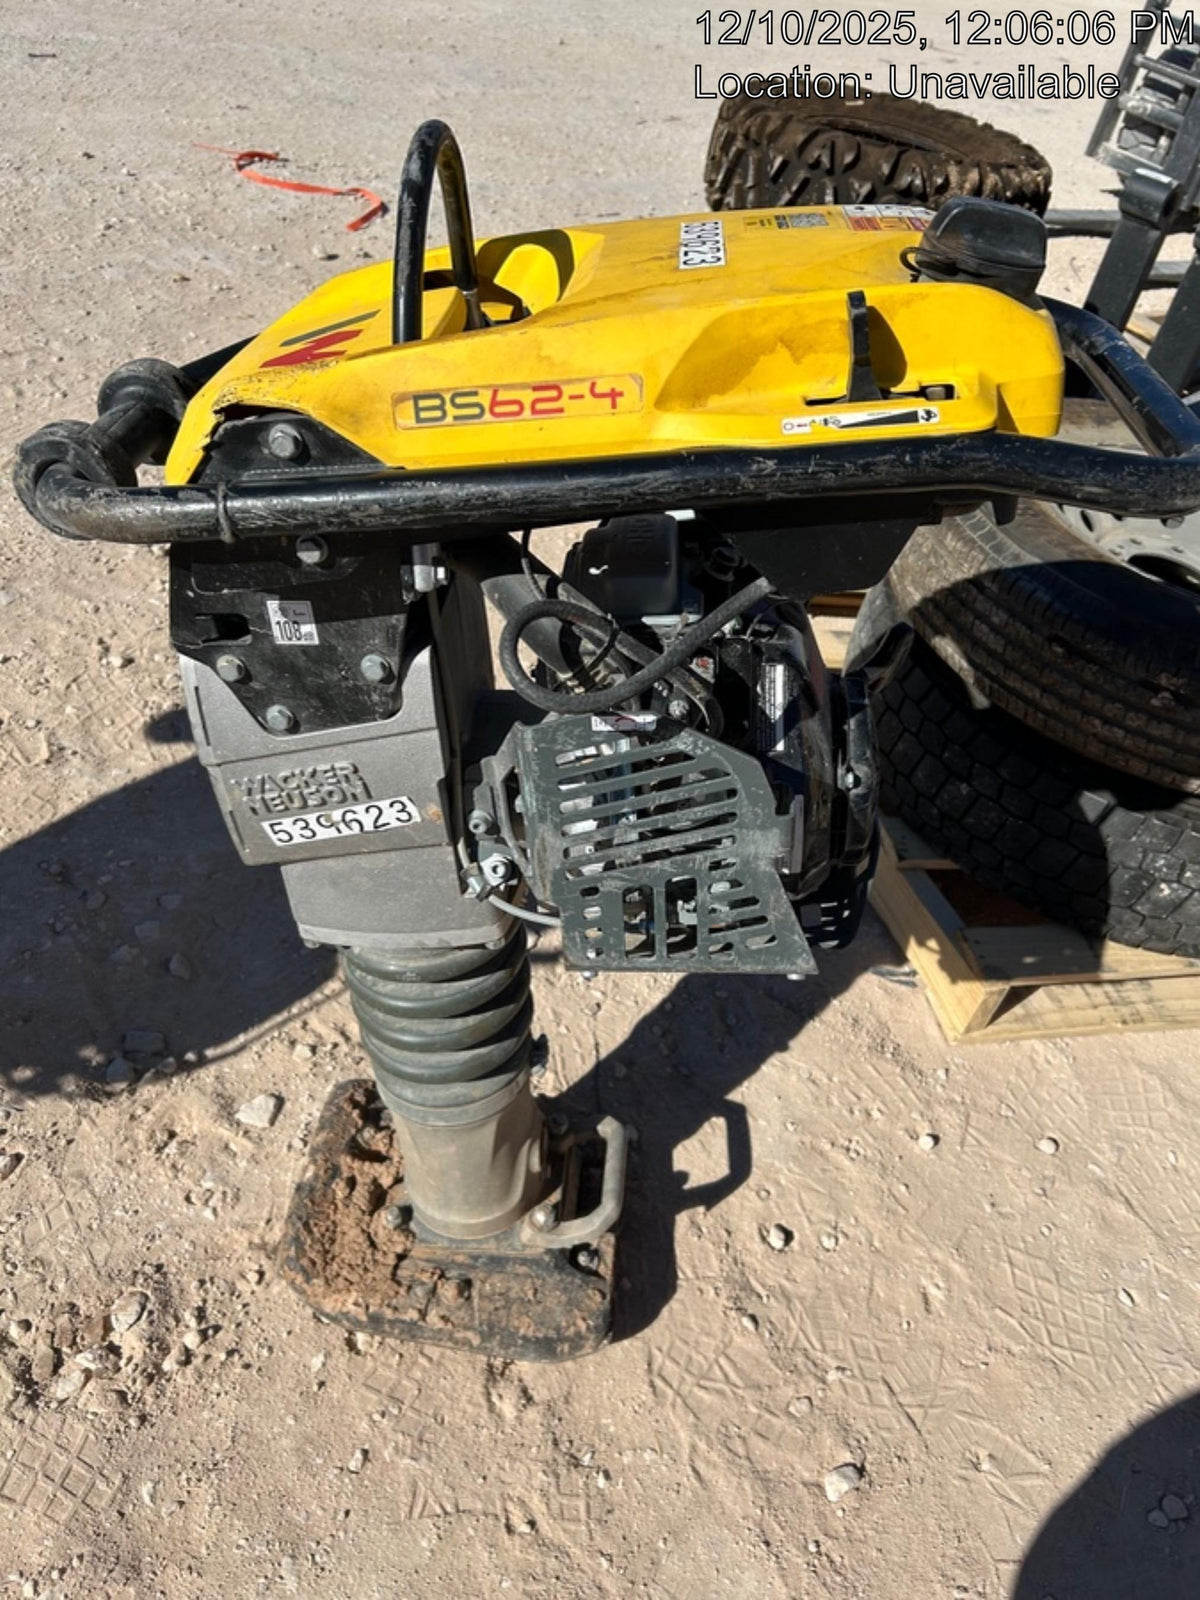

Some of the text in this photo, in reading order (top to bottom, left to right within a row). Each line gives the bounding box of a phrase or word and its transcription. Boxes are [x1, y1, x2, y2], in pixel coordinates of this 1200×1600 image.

[412, 381, 624, 424] BS62-4
[275, 620, 303, 641] 108
[241, 774, 373, 816] NEUSON
[269, 799, 412, 843] 539623
